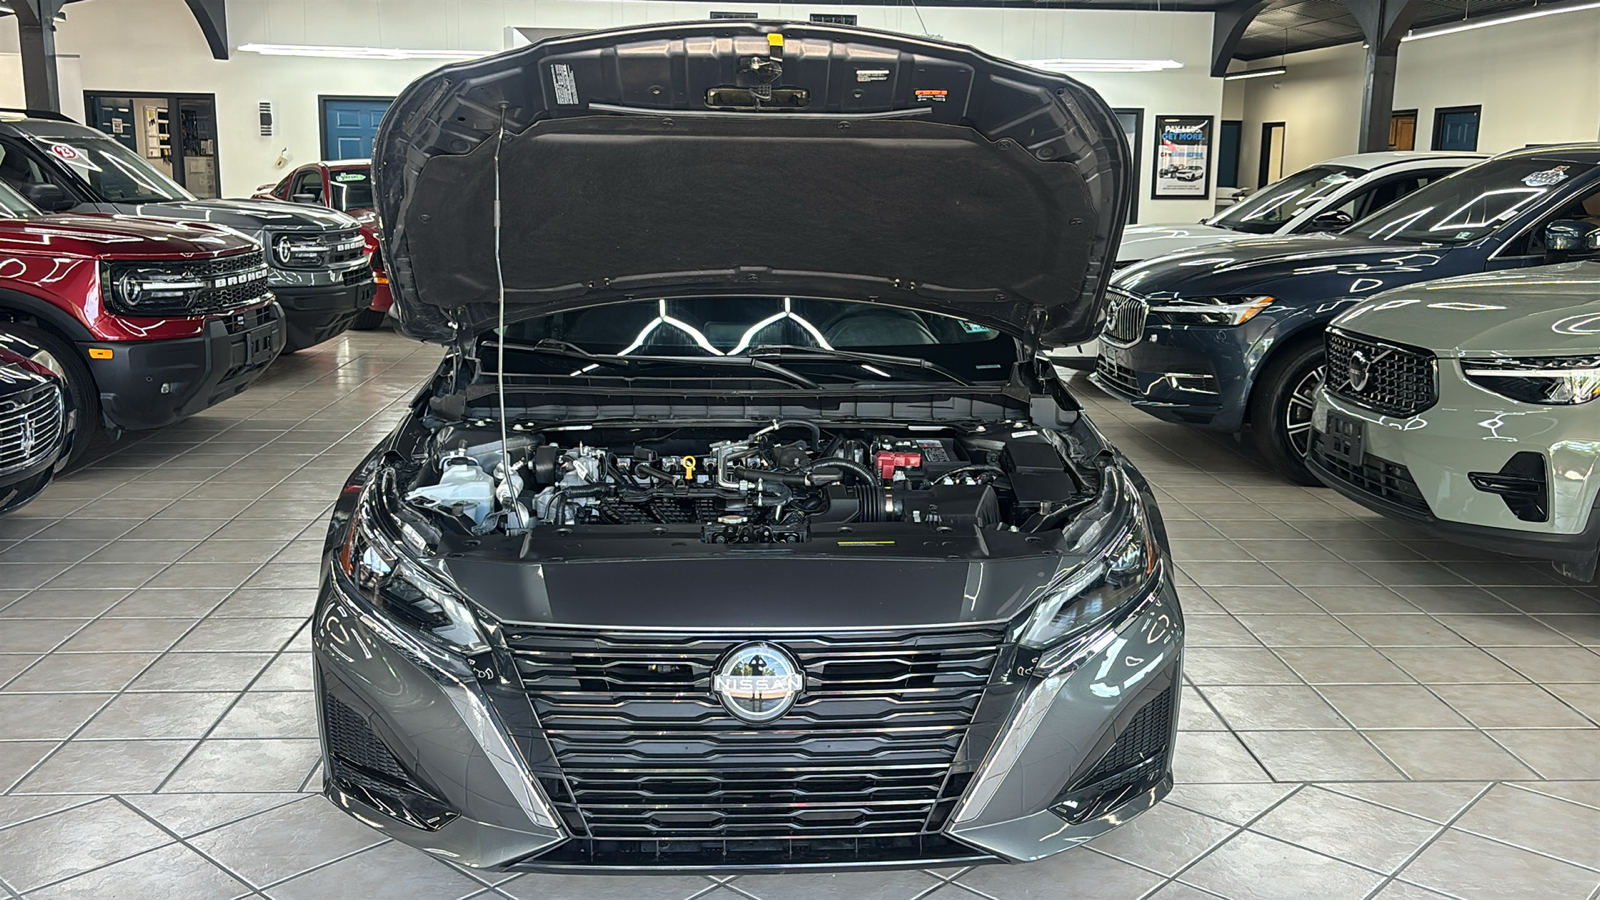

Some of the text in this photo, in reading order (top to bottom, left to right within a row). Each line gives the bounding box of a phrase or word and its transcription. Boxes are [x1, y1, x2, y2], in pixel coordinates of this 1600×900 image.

[1165, 125, 1180, 133] PAY
[1162, 133, 1205, 141] GET MORE.
[215, 269, 267, 288] BRONCO
[716, 676, 800, 690] NISSAN
